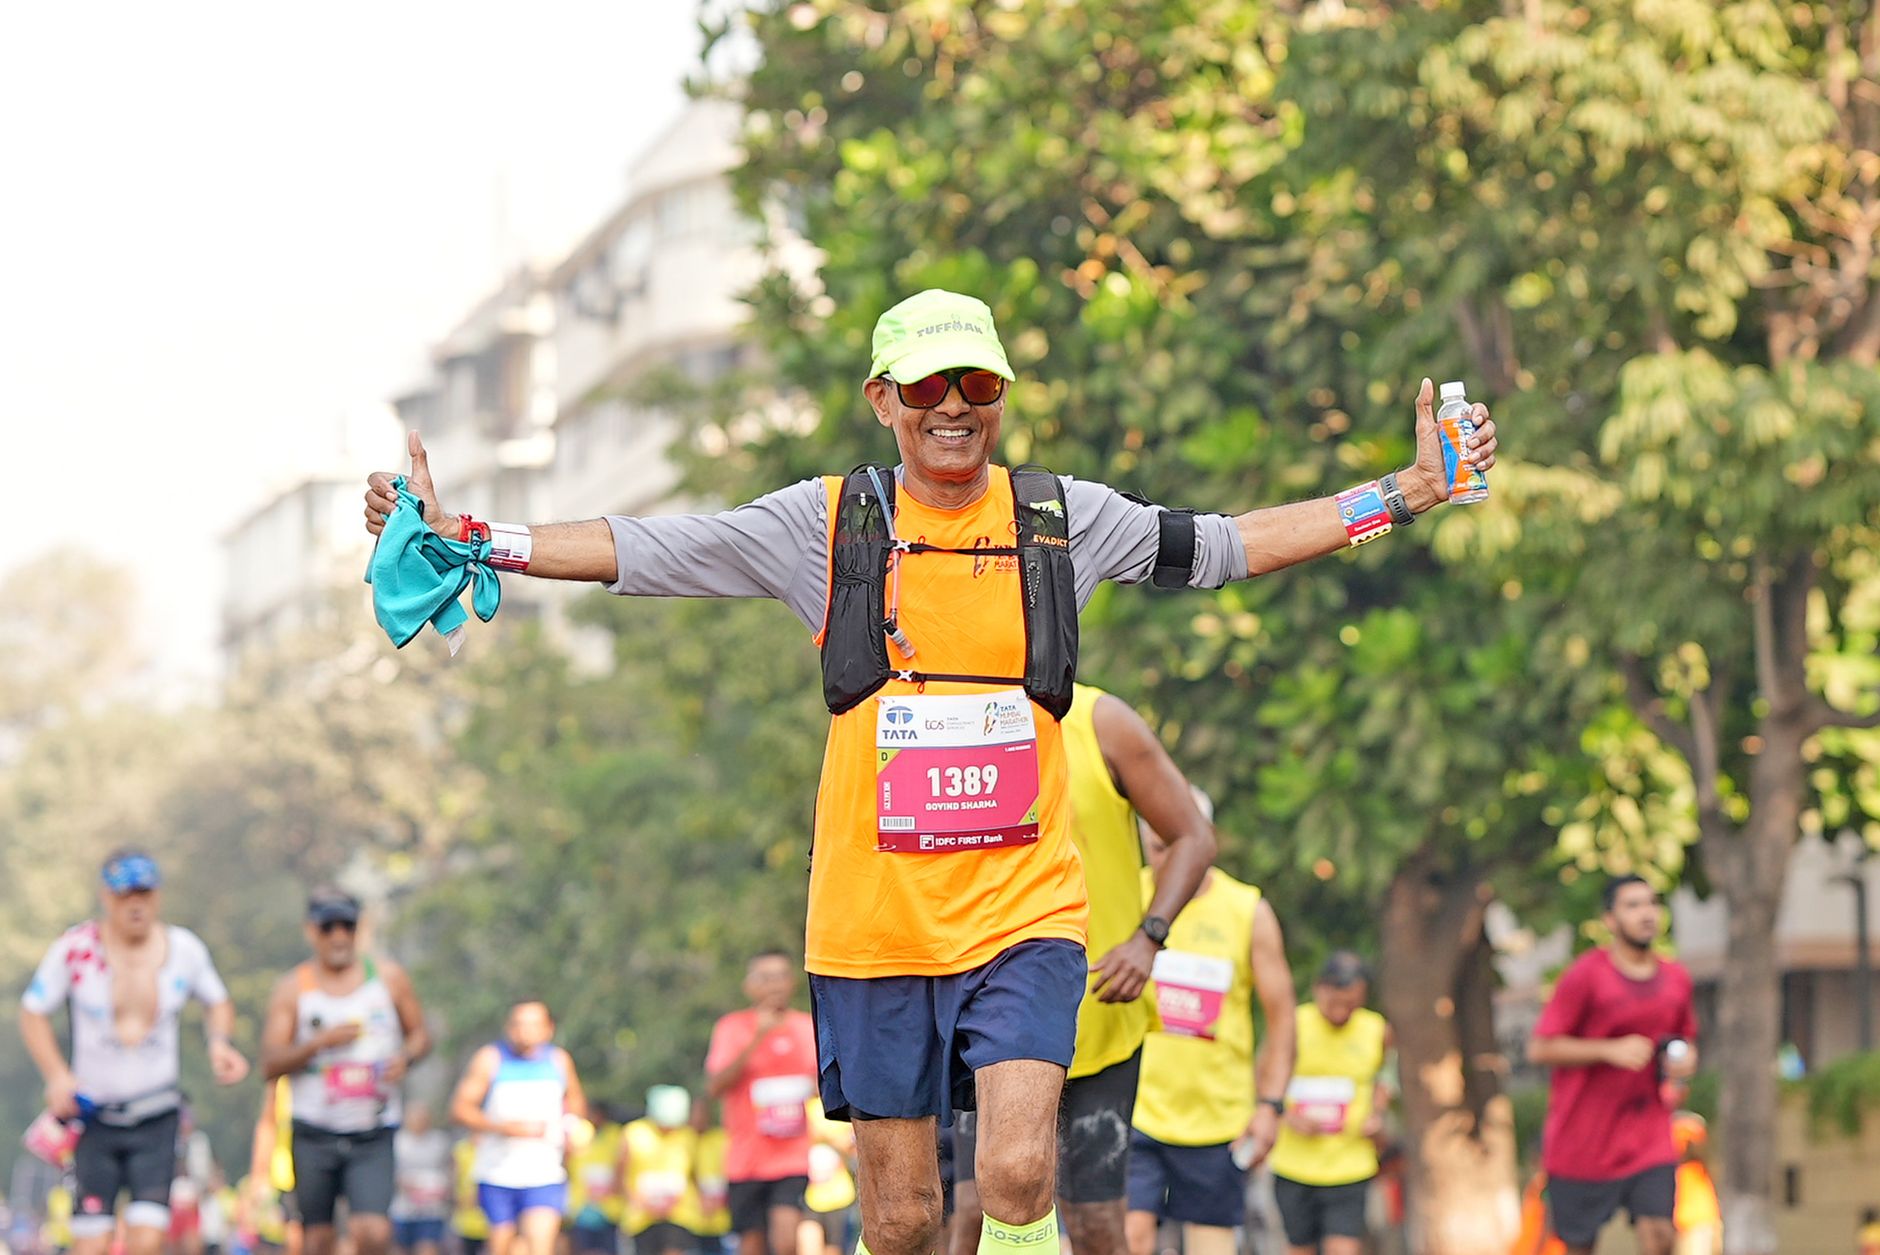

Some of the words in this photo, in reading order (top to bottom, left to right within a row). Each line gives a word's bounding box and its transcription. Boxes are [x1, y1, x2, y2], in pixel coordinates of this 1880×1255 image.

[1033, 534, 1068, 547] EVADICT
[925, 718, 945, 730] tcs
[882, 730, 918, 740] TATA
[881, 752, 888, 761] D
[927, 764, 999, 797] 1389
[925, 802, 960, 811] GOVIND
[960, 799, 998, 810] SHARMA
[935, 837, 956, 846] IDFC
[957, 836, 982, 845] FIRST
[983, 834, 1004, 844] Bank
